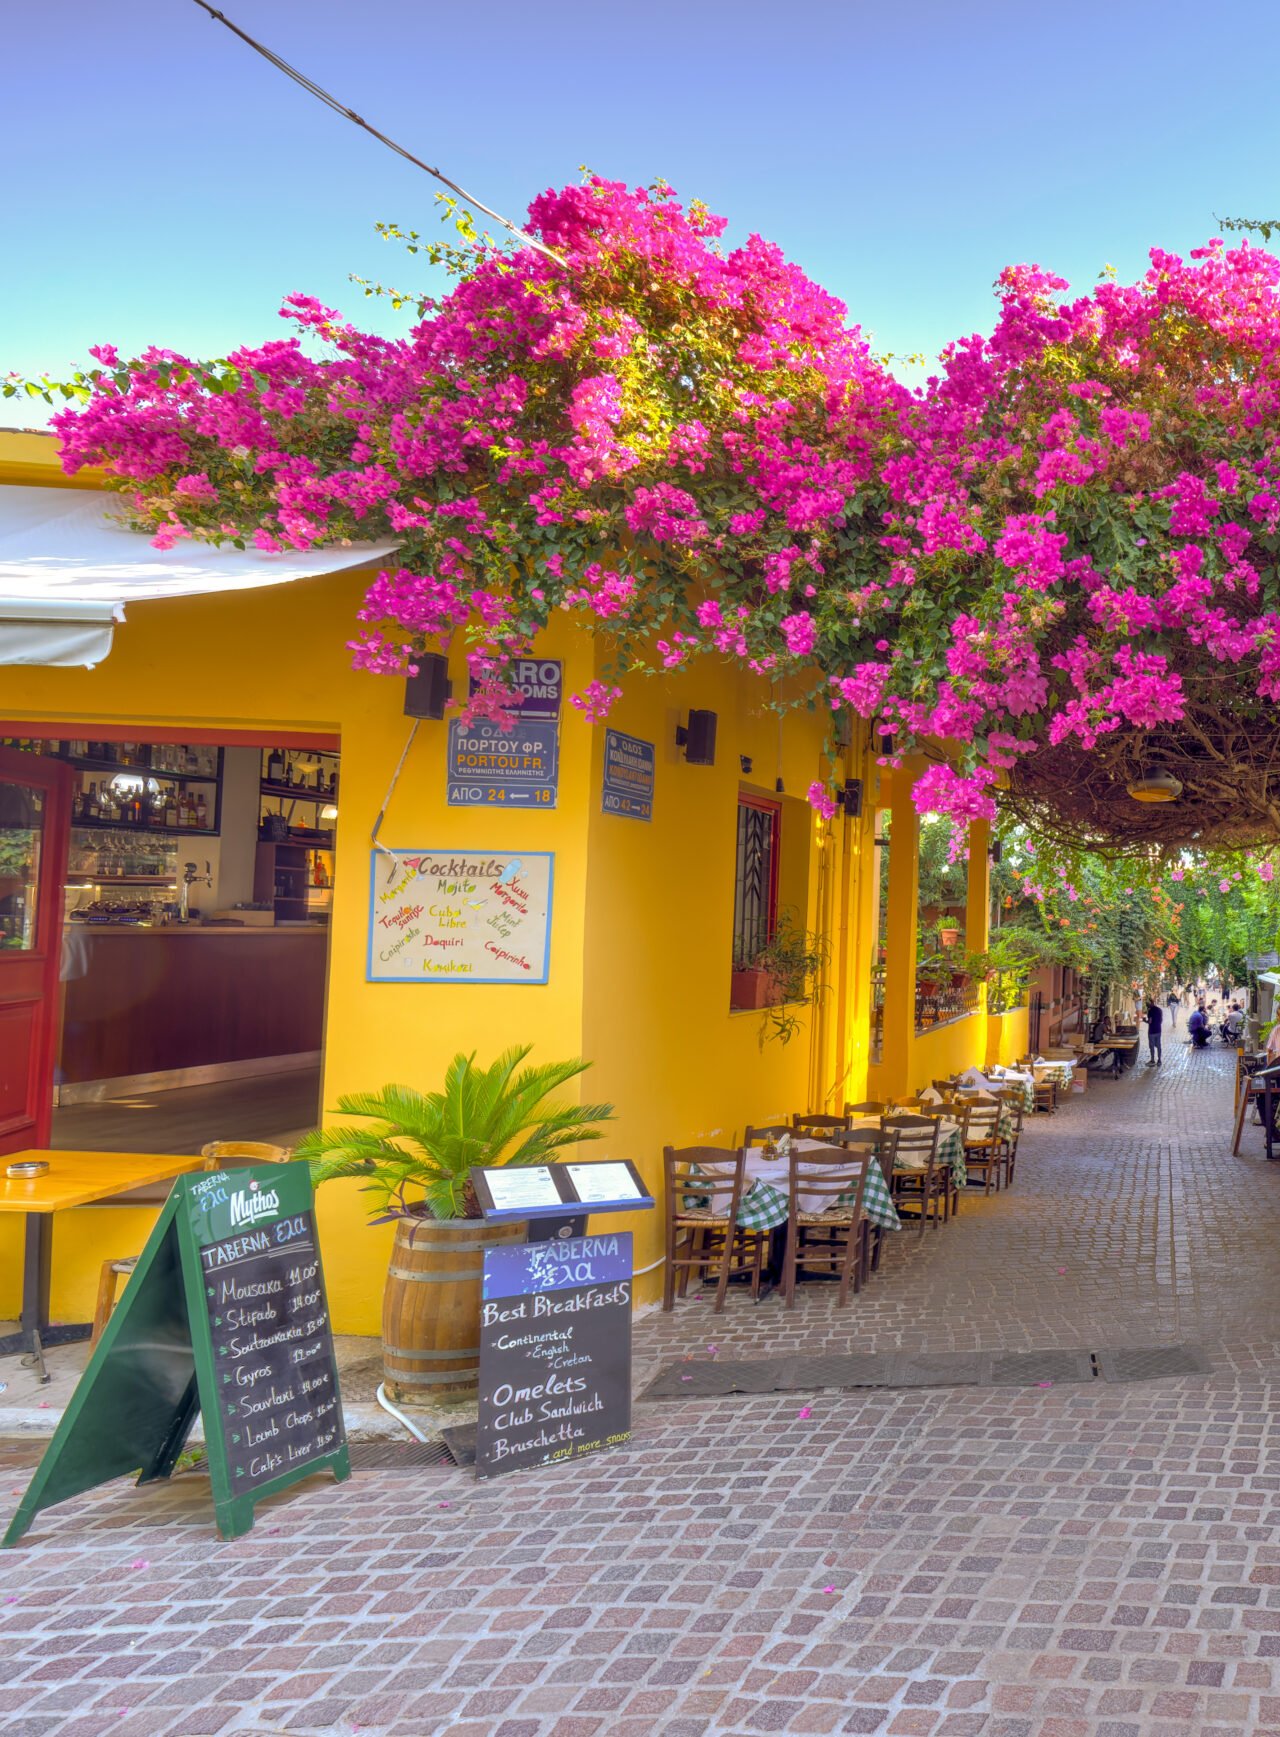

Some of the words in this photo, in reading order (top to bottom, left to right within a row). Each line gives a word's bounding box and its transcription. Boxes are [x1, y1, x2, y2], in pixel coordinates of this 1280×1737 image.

[458, 739, 518, 753] ΠΟΡΤΟΥ
[522, 742, 547, 754] ΦΡ.
[457, 754, 519, 768] PORTOU
[523, 758, 546, 769] FR.
[451, 788, 482, 800] ΑΠΟ
[488, 789, 505, 801] 24
[535, 790, 550, 802] 18
[418, 857, 504, 877] Cocktails
[437, 879, 476, 896] Mojito
[438, 917, 467, 929] Libre
[190, 1172, 231, 1195] TABERNA
[230, 1189, 280, 1226] Mythos
[202, 1231, 271, 1268] TABERNA
[524, 1236, 619, 1267] TABERNA
[222, 1277, 283, 1304] Mousaka
[226, 1302, 276, 1331] Stifado
[483, 1302, 527, 1327] Best
[497, 1326, 574, 1350] Continental
[554, 1353, 592, 1369] Cretan
[236, 1365, 272, 1387] Gyros
[240, 1385, 295, 1418] Souvlaki
[493, 1374, 587, 1406] Omelets
[495, 1408, 533, 1430] Club
[538, 1392, 604, 1422] Sandwich
[246, 1418, 279, 1448] Lamb
[286, 1411, 313, 1429] Chops
[288, 1443, 311, 1460] Liver
[490, 1422, 585, 1463] Bruschetta
[553, 1442, 573, 1459] and
[577, 1440, 602, 1453] more
